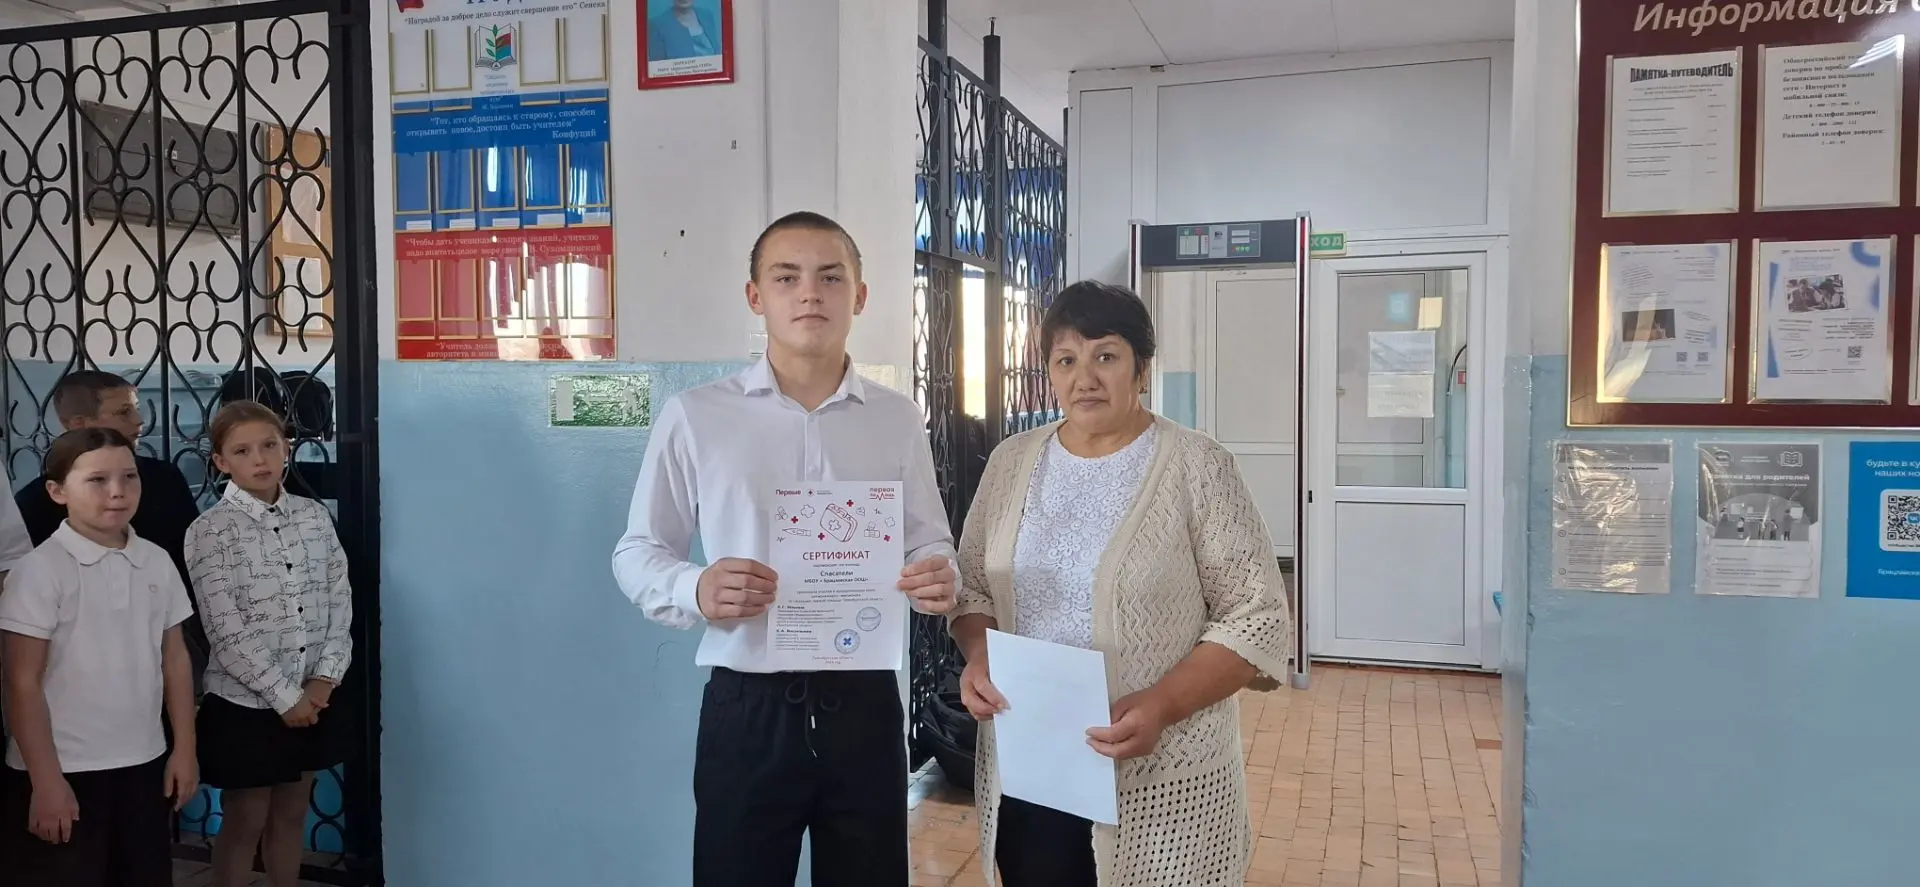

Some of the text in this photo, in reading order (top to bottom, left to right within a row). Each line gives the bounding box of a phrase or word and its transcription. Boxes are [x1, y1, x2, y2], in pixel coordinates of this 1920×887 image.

[1633, 0, 1897, 37] Информация
[1629, 62, 1734, 83] ПАМЯТКА-ПУТЕВОДИТЕЛЬ
[552, 128, 596, 139] Конфуций
[1310, 237, 1342, 247] ХОД
[1866, 458, 1900, 469] будьте
[1762, 473, 1811, 481] родителей
[802, 550, 871, 561] СЕРТИФИКАТ
